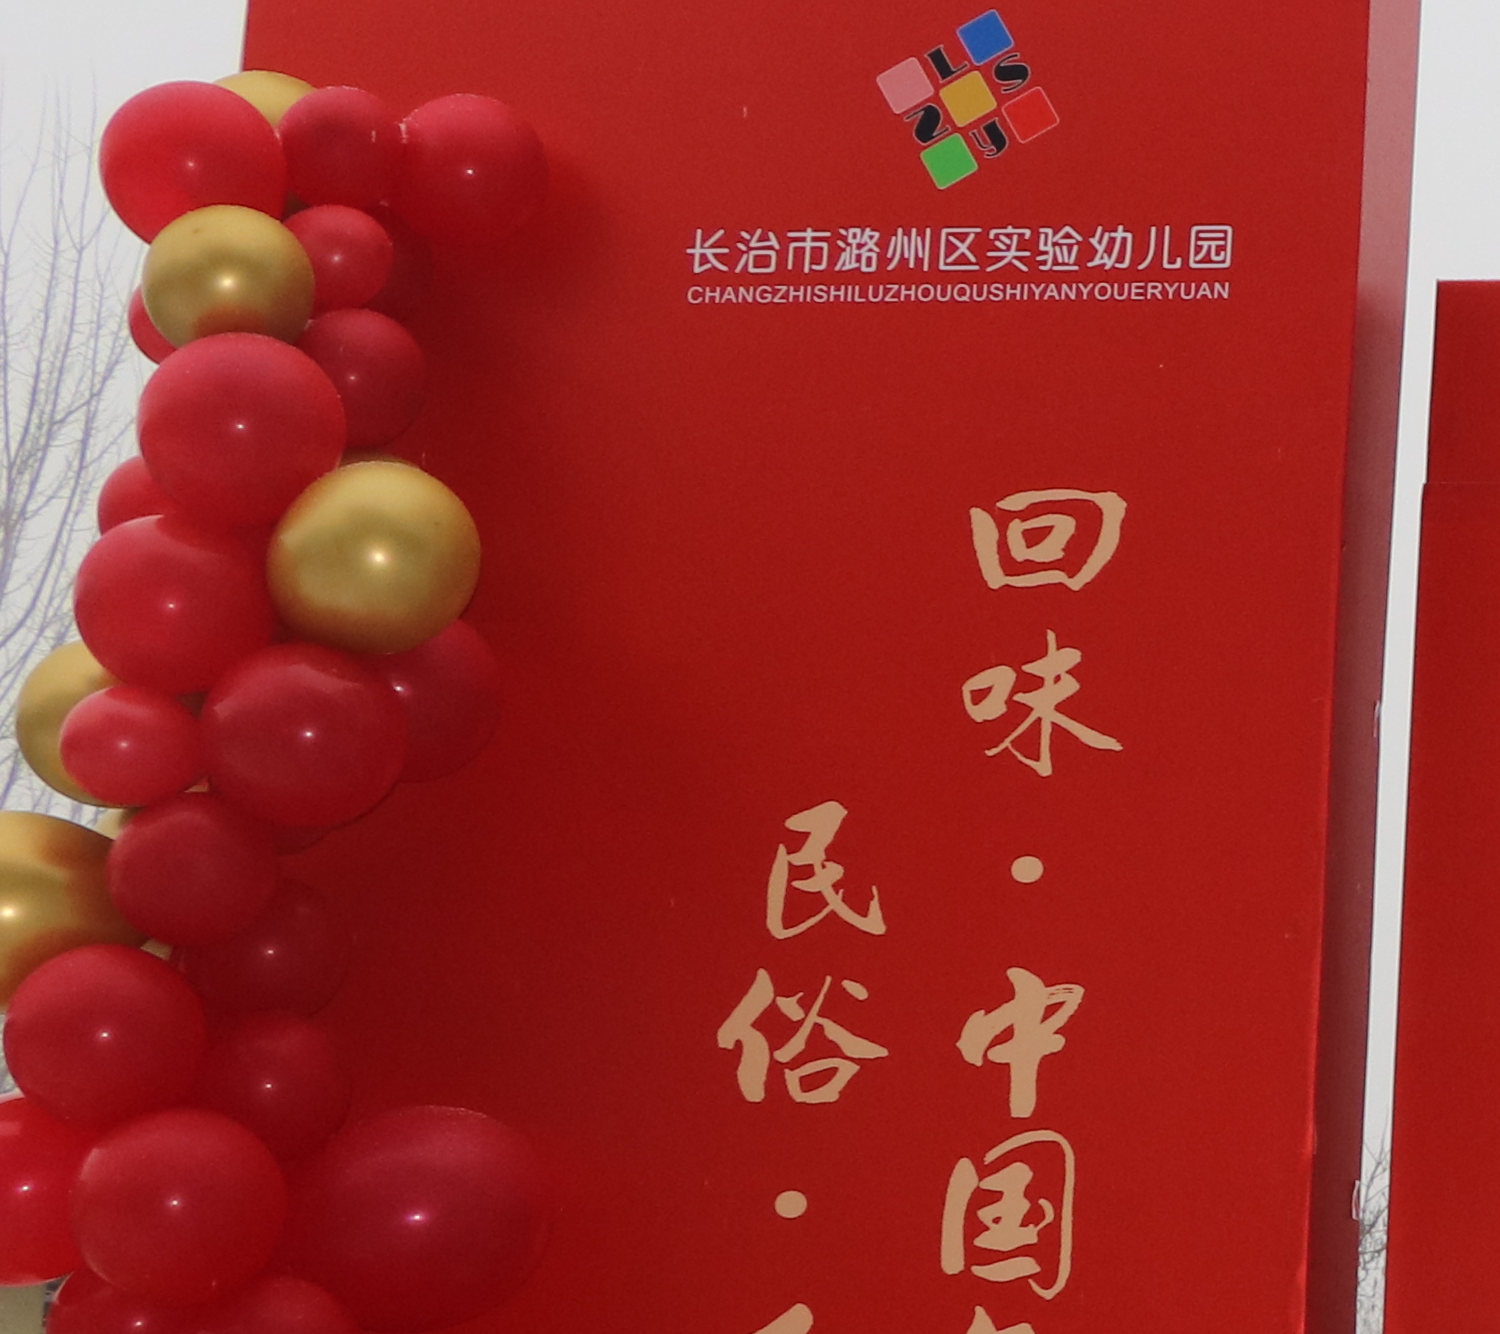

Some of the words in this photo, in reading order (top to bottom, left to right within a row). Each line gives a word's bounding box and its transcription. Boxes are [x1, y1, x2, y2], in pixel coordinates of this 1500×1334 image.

[925, 45, 969, 82] L
[993, 53, 1031, 94] S
[685, 224, 1233, 274] 长治市潞州区实验幼儿园
[686, 281, 1230, 305] CHANGZHISHILUZHOUQUSHIYANYOUERYUAN
